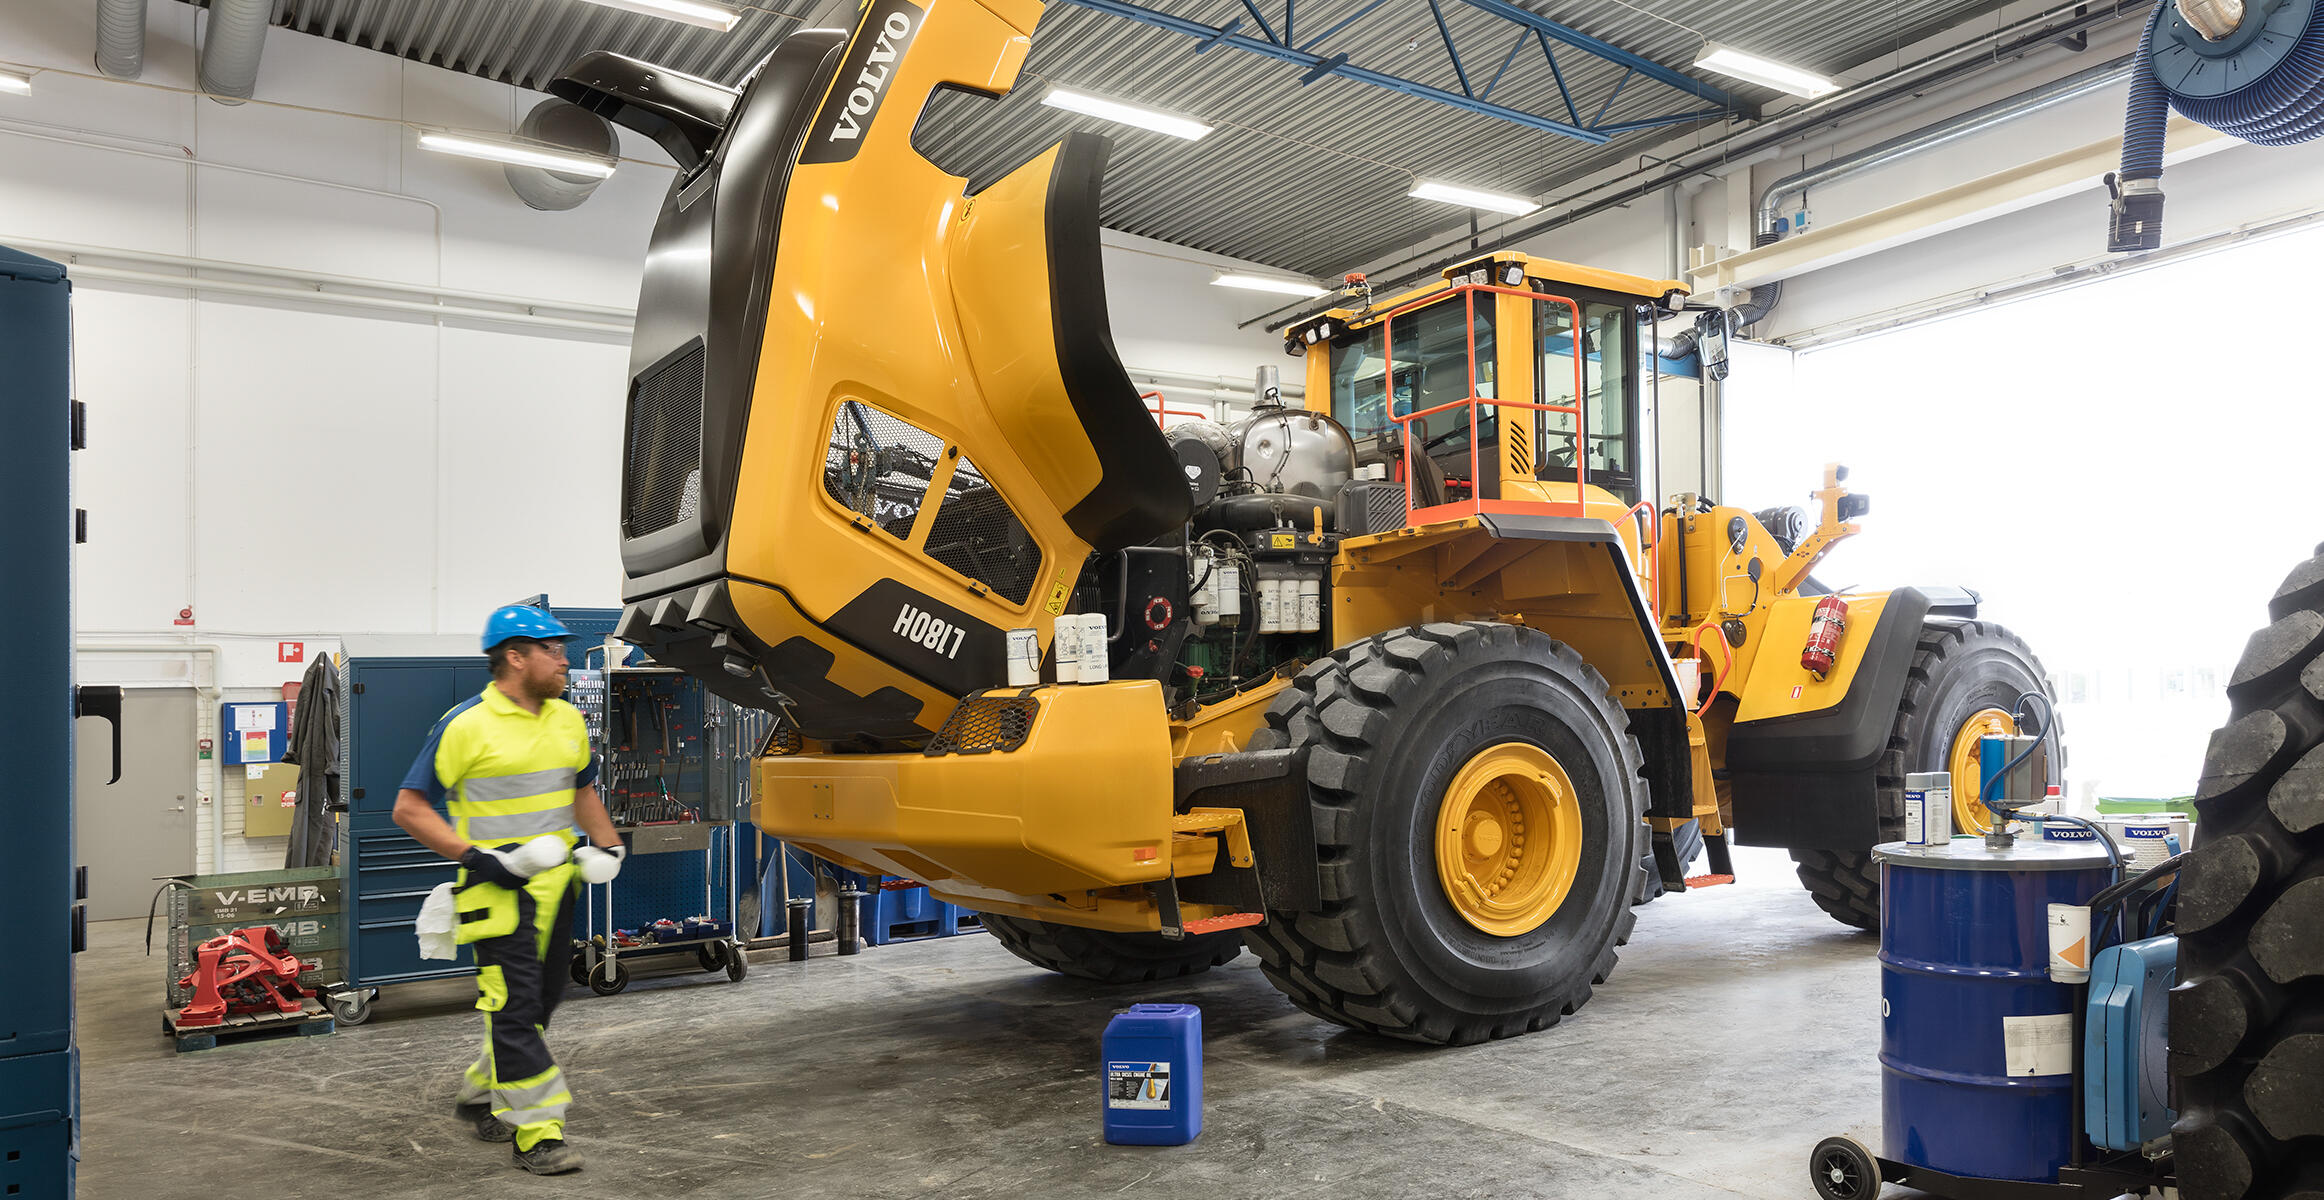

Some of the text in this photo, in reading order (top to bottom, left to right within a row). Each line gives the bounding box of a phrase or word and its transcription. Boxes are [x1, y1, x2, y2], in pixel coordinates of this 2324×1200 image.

[828, 11, 911, 143] VOLVO
[892, 603, 966, 660] L180H
[2051, 830, 2092, 839] VOLVO
[215, 885, 320, 906] V-EMB
